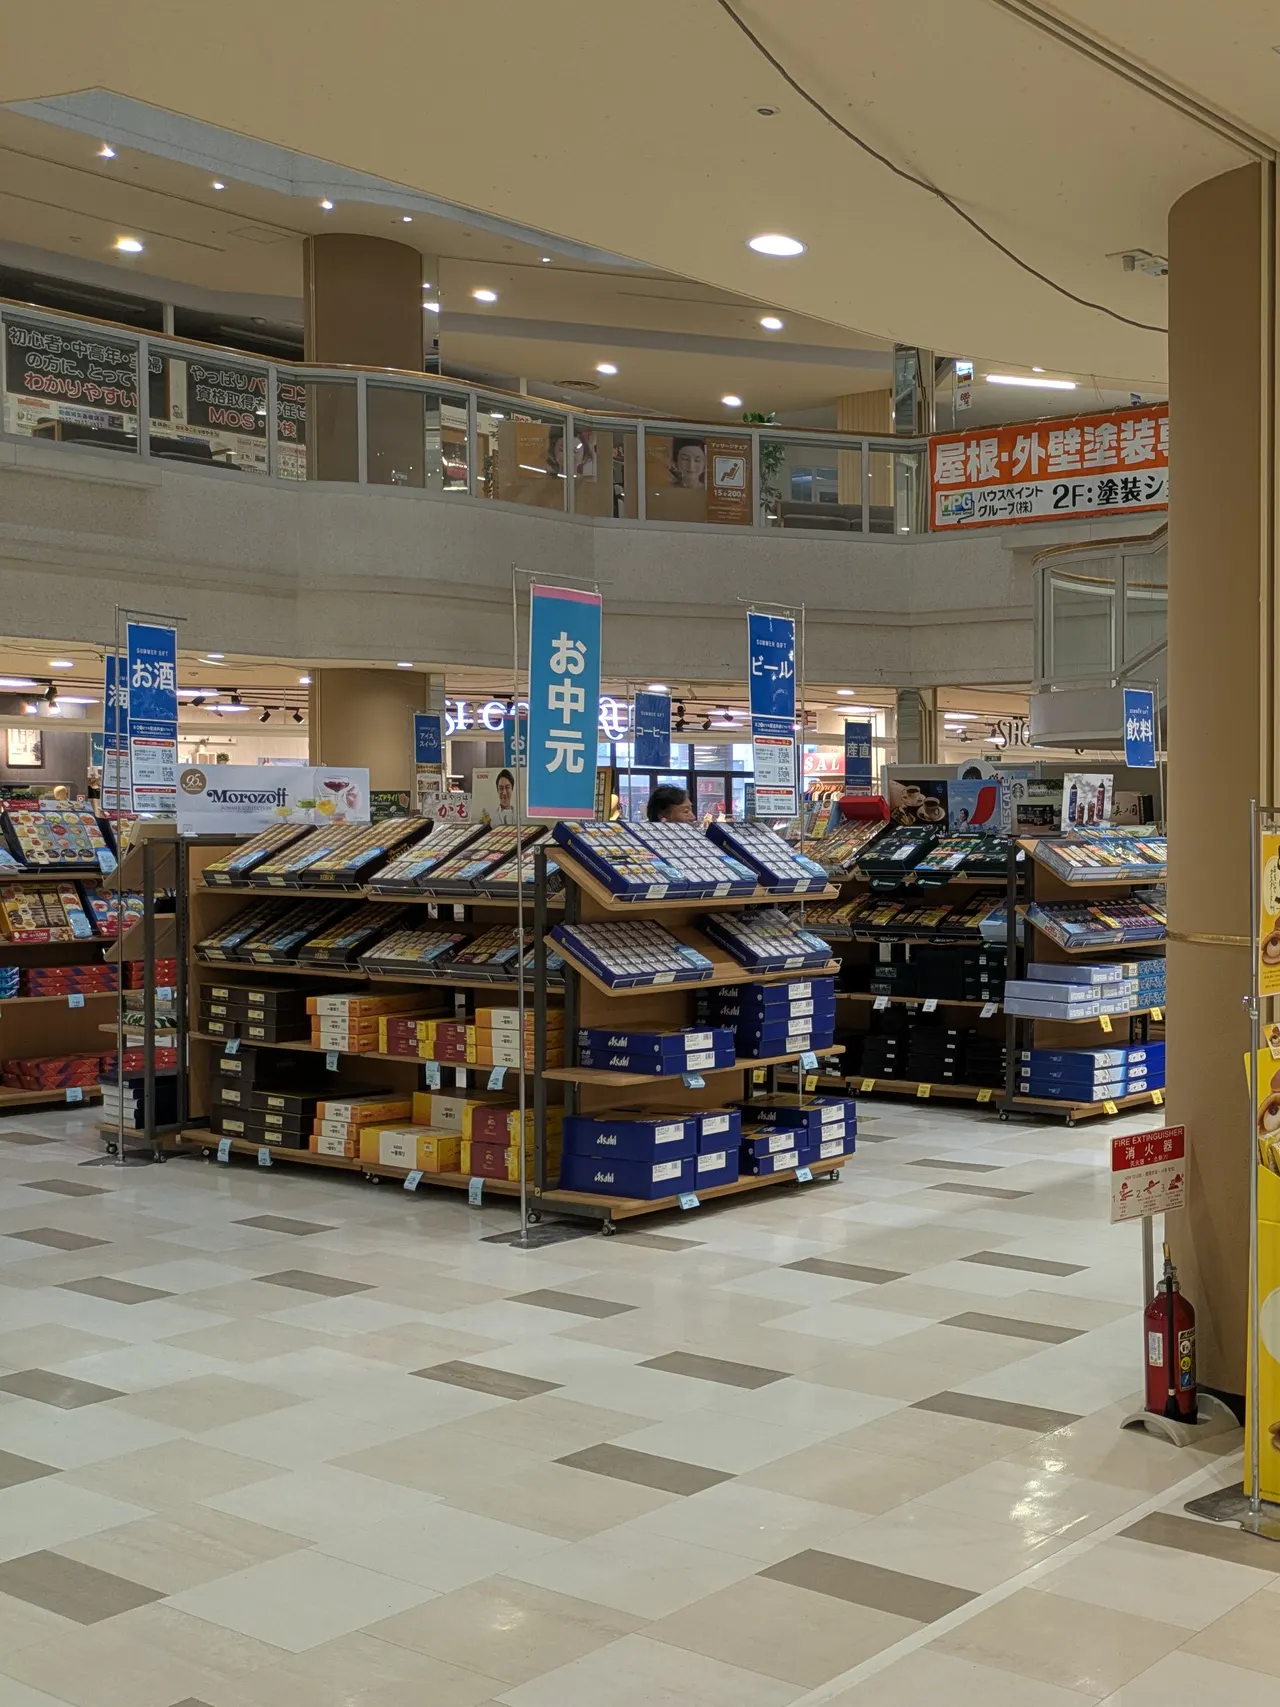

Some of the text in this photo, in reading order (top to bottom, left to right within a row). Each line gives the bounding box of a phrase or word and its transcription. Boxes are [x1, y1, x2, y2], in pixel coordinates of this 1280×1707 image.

[24, 370, 138, 407] わかりやすい
[190, 364, 306, 403] やっぱりパコン
[196, 384, 306, 421] 資格取得も任せ
[208, 406, 296, 438] MOS・検
[978, 485, 1044, 503] ハウスペイント
[1052, 475, 1168, 510] 2F:塗装シ
[978, 500, 1033, 519] グループ(株)
[131, 658, 175, 690] お酒
[751, 655, 793, 679] ビール
[545, 631, 588, 773] お中元
[636, 726, 669, 738] コーヒー
[1126, 717, 1153, 742] 飲料
[846, 741, 871, 760] 産直
[206, 787, 289, 808] Morozoff
[718, 987, 738, 998] Asahi
[720, 1005, 740, 1016] Asahi
[608, 1035, 628, 1048] Asahi
[609, 1055, 630, 1067] Asahi
[757, 1110, 777, 1122] Asahi
[596, 1133, 617, 1146] Asahi
[1114, 1128, 1183, 1148] FIRE EXTINGUISHER
[1125, 1139, 1173, 1160] 消火器
[594, 1170, 614, 1183] Asahi
